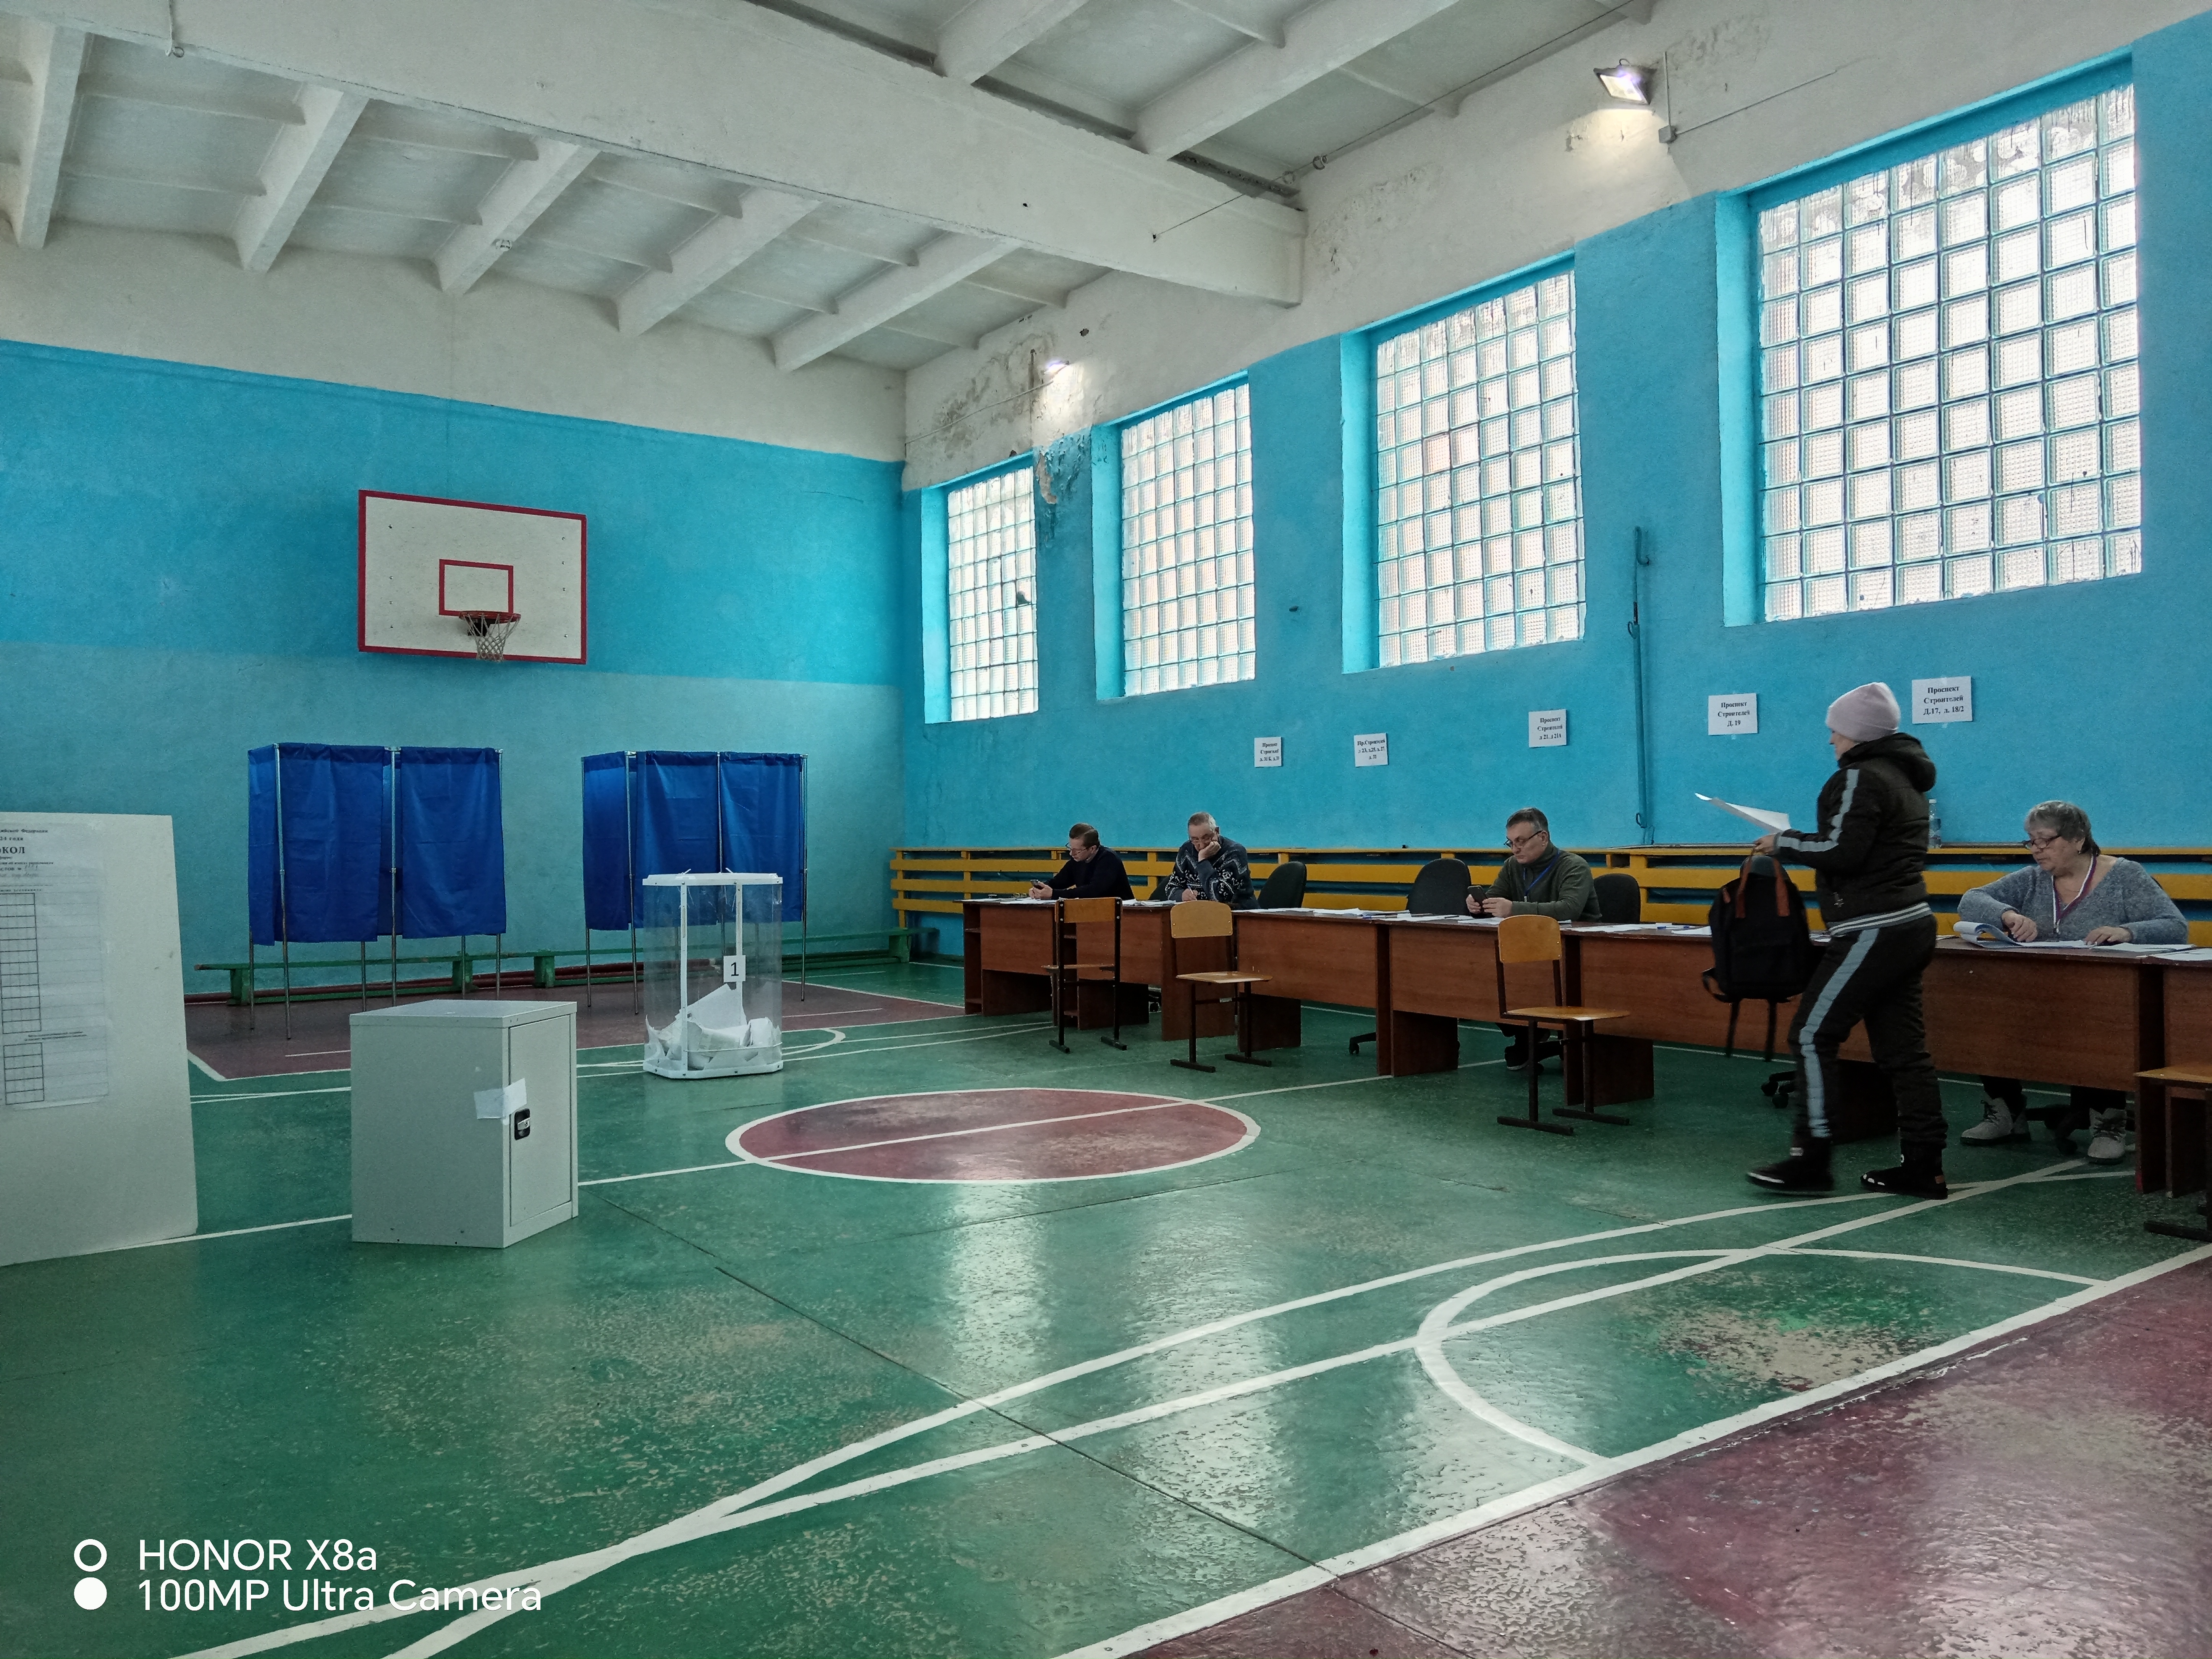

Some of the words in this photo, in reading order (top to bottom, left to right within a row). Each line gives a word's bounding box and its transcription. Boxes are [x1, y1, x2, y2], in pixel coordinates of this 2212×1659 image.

[1927, 686, 1960, 694] Проспект
[1924, 695, 1964, 705] Строителей
[731, 962, 739, 977] 1
